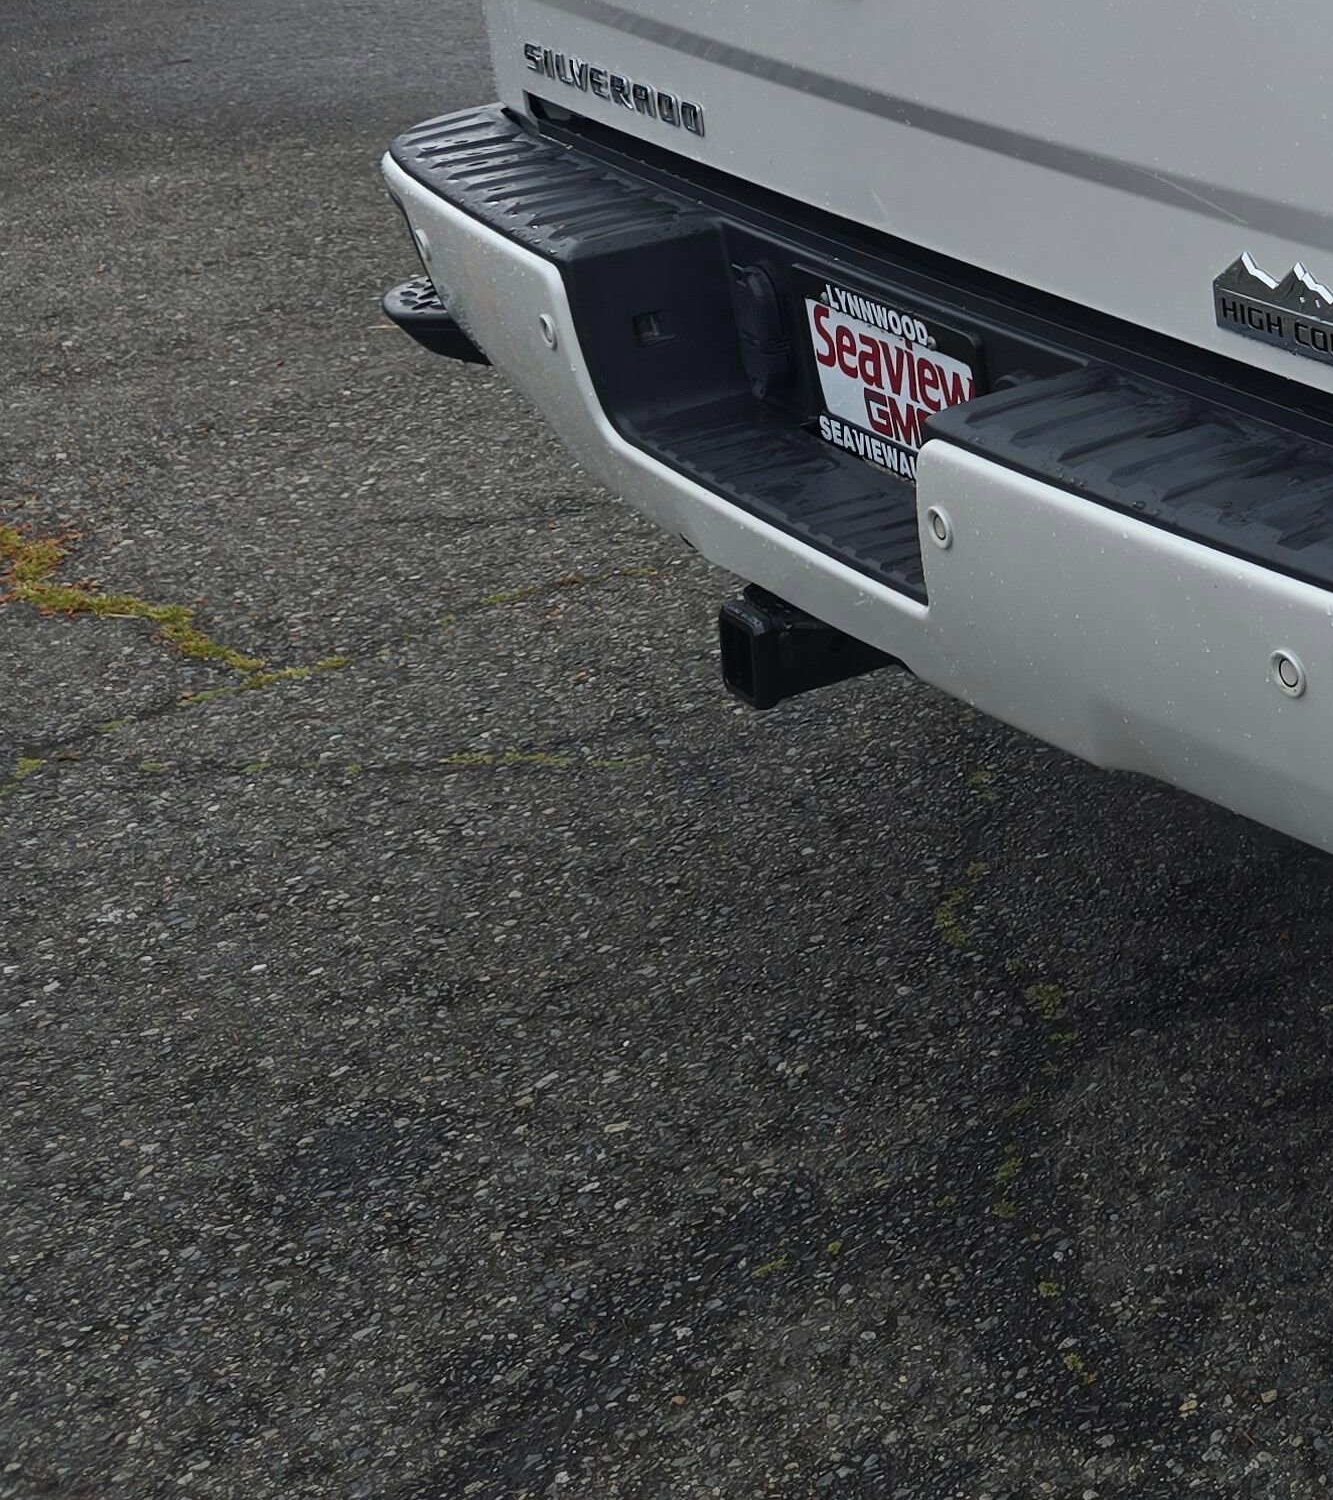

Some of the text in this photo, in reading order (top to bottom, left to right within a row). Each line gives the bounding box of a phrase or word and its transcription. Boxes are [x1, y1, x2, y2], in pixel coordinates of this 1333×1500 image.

[524, 41, 705, 137] SILVERADO
[825, 283, 929, 346] LYNNWOOD
[1222, 297, 1283, 338] HIGH
[814, 304, 975, 412] Seaview
